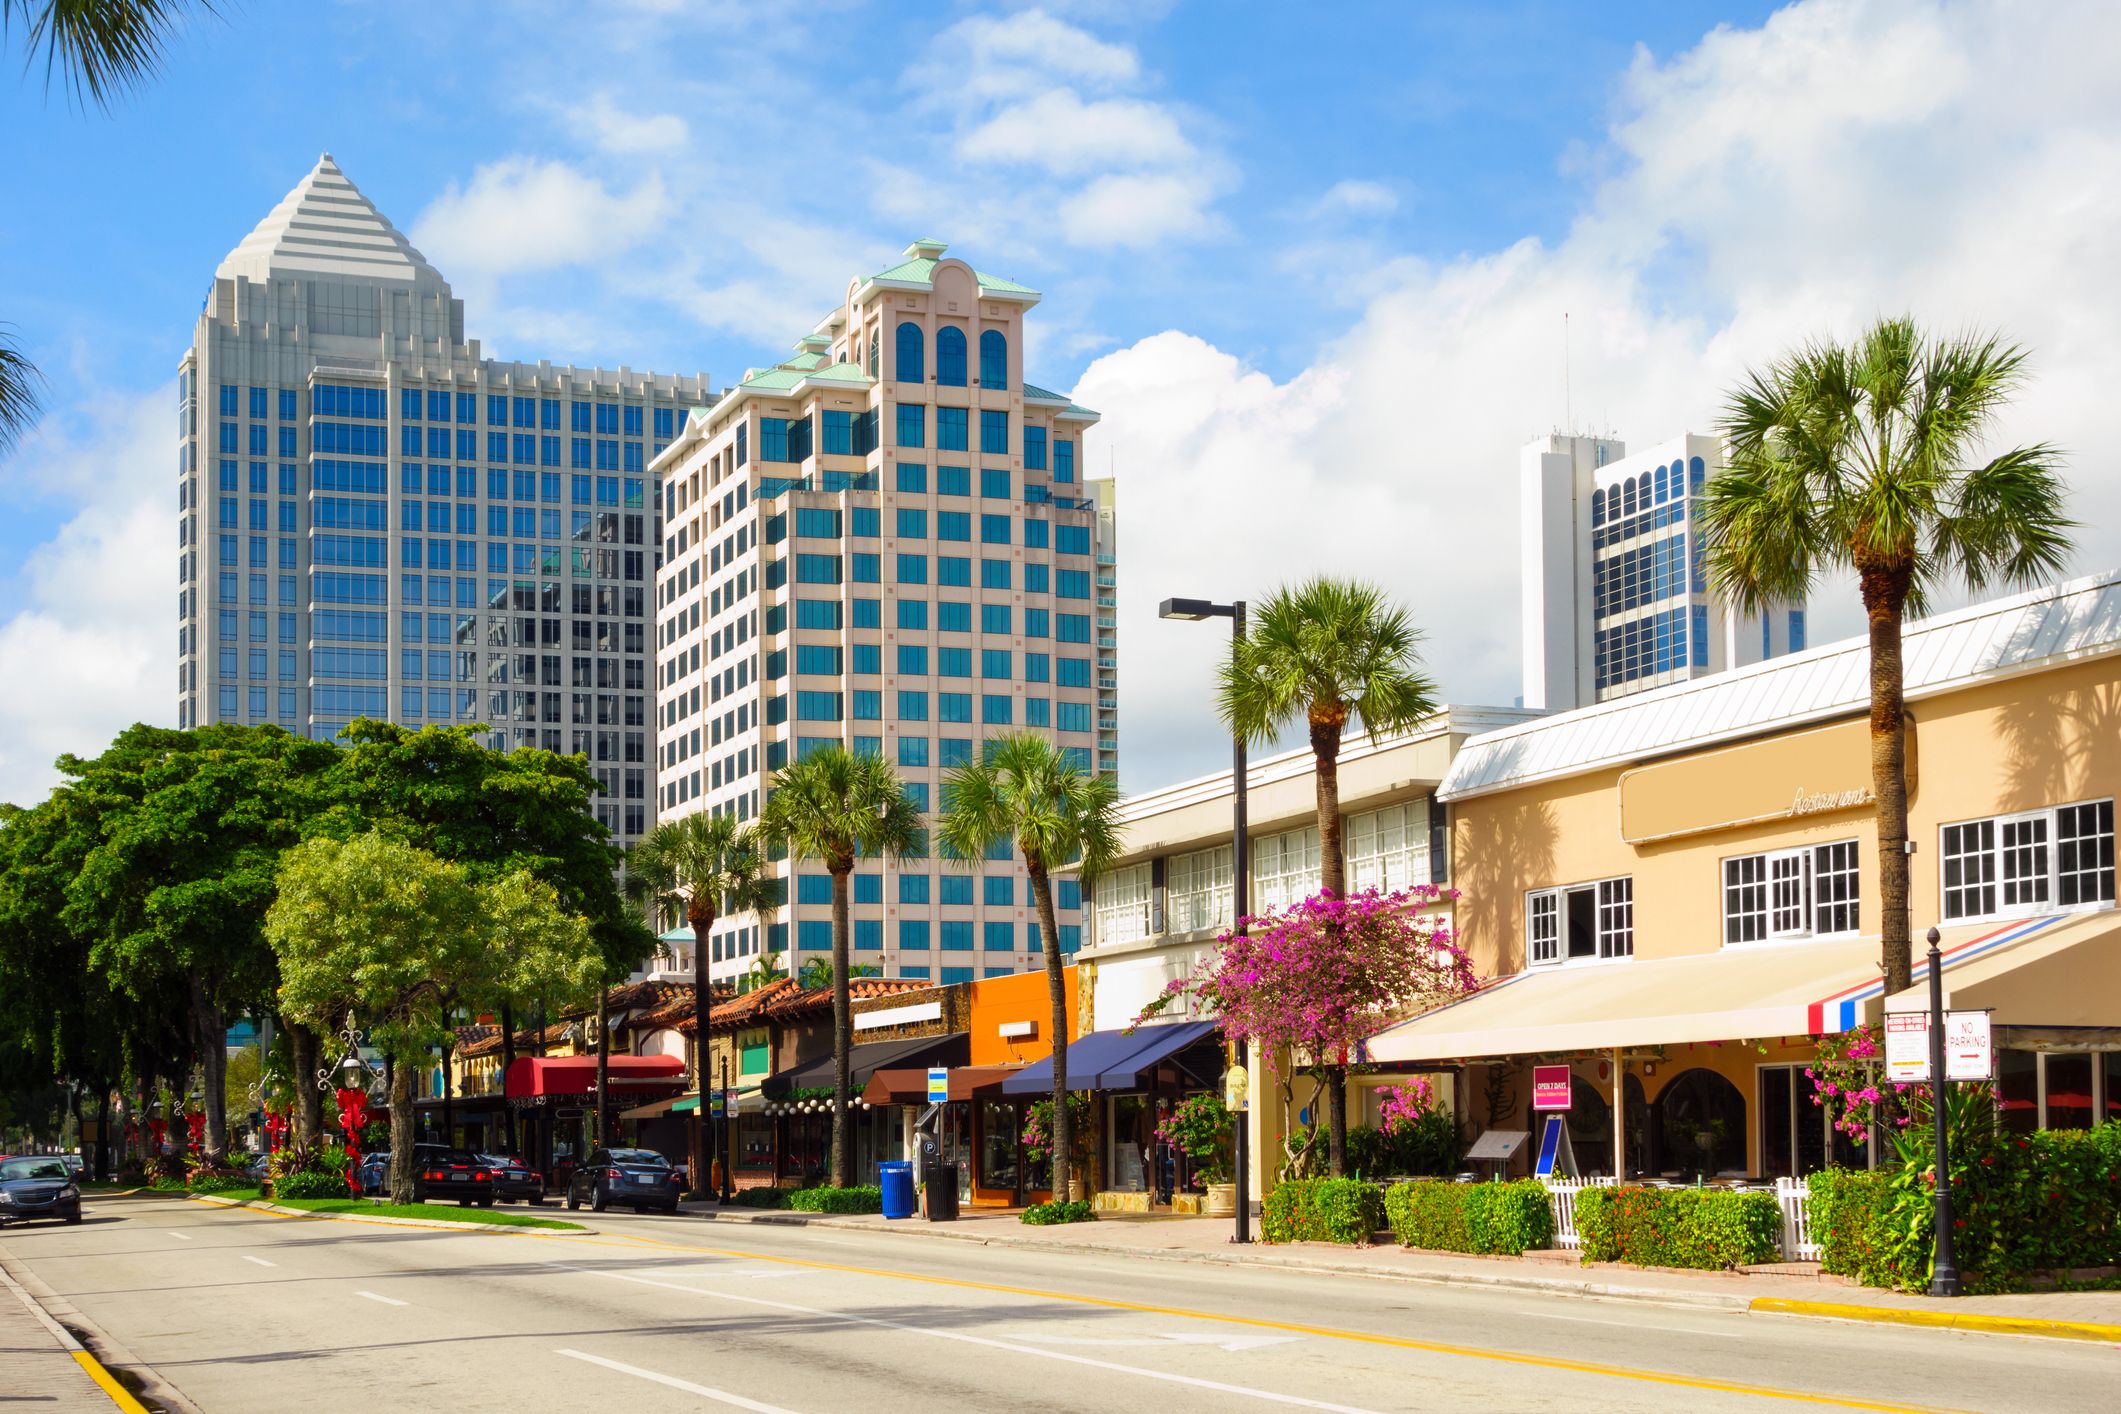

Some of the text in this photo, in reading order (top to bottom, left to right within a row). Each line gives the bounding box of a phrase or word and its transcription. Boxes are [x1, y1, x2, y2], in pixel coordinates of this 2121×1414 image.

[1787, 786, 1866, 817] Restaurant
[1961, 1021, 1973, 1034] NO
[1950, 1035, 1986, 1048] PARKING
[926, 1143, 933, 1152] P
